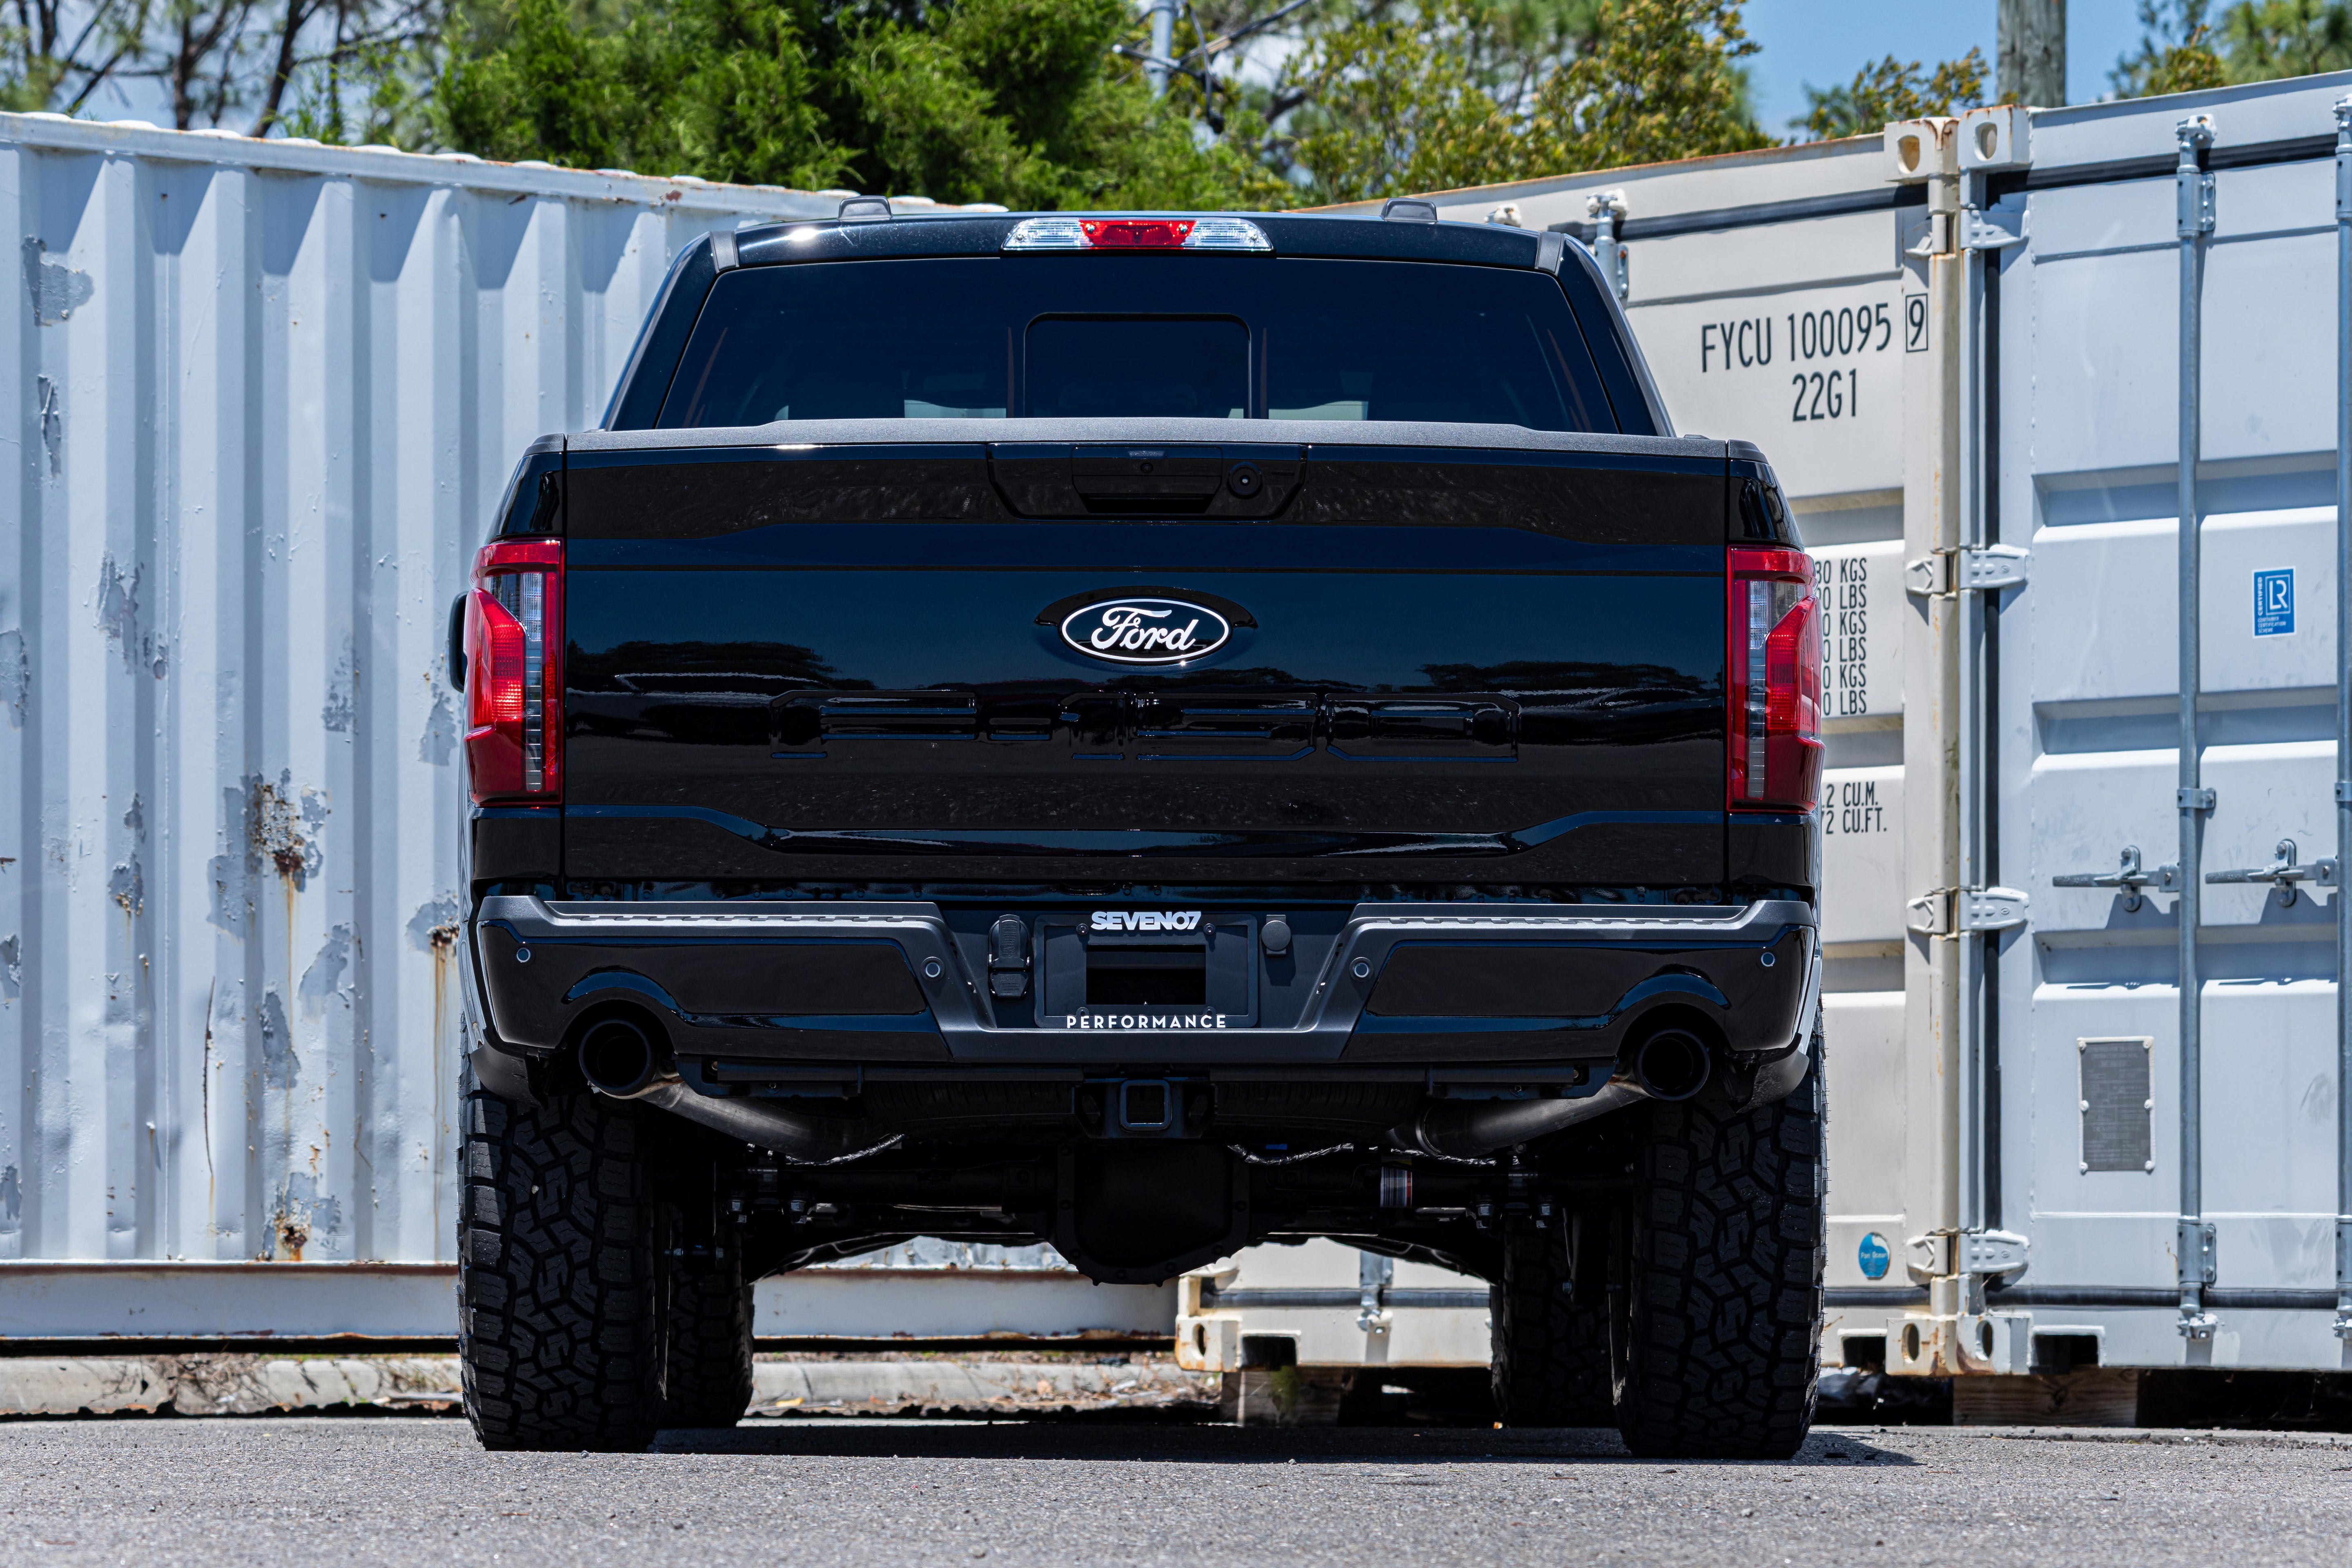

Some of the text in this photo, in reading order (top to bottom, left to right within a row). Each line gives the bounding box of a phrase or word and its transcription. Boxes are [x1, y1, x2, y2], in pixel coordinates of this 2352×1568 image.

[1702, 298, 1924, 372] FYCU 100095 9
[1792, 368, 1857, 422] 22G1
[1840, 557, 1866, 583] KGS
[1840, 584, 1866, 610] LBS
[2269, 579, 2288, 610] LR
[1091, 607, 1199, 650] Ford
[1840, 610, 1866, 635] KGS
[1840, 637, 1866, 662] LBS
[1840, 663, 1866, 688] KGS
[1840, 689, 1866, 715] LBS
[1843, 781, 1878, 807] CU.M.
[1843, 807, 1887, 833] CU.FT.
[1066, 1014, 1226, 1029] PERFORMANCE
